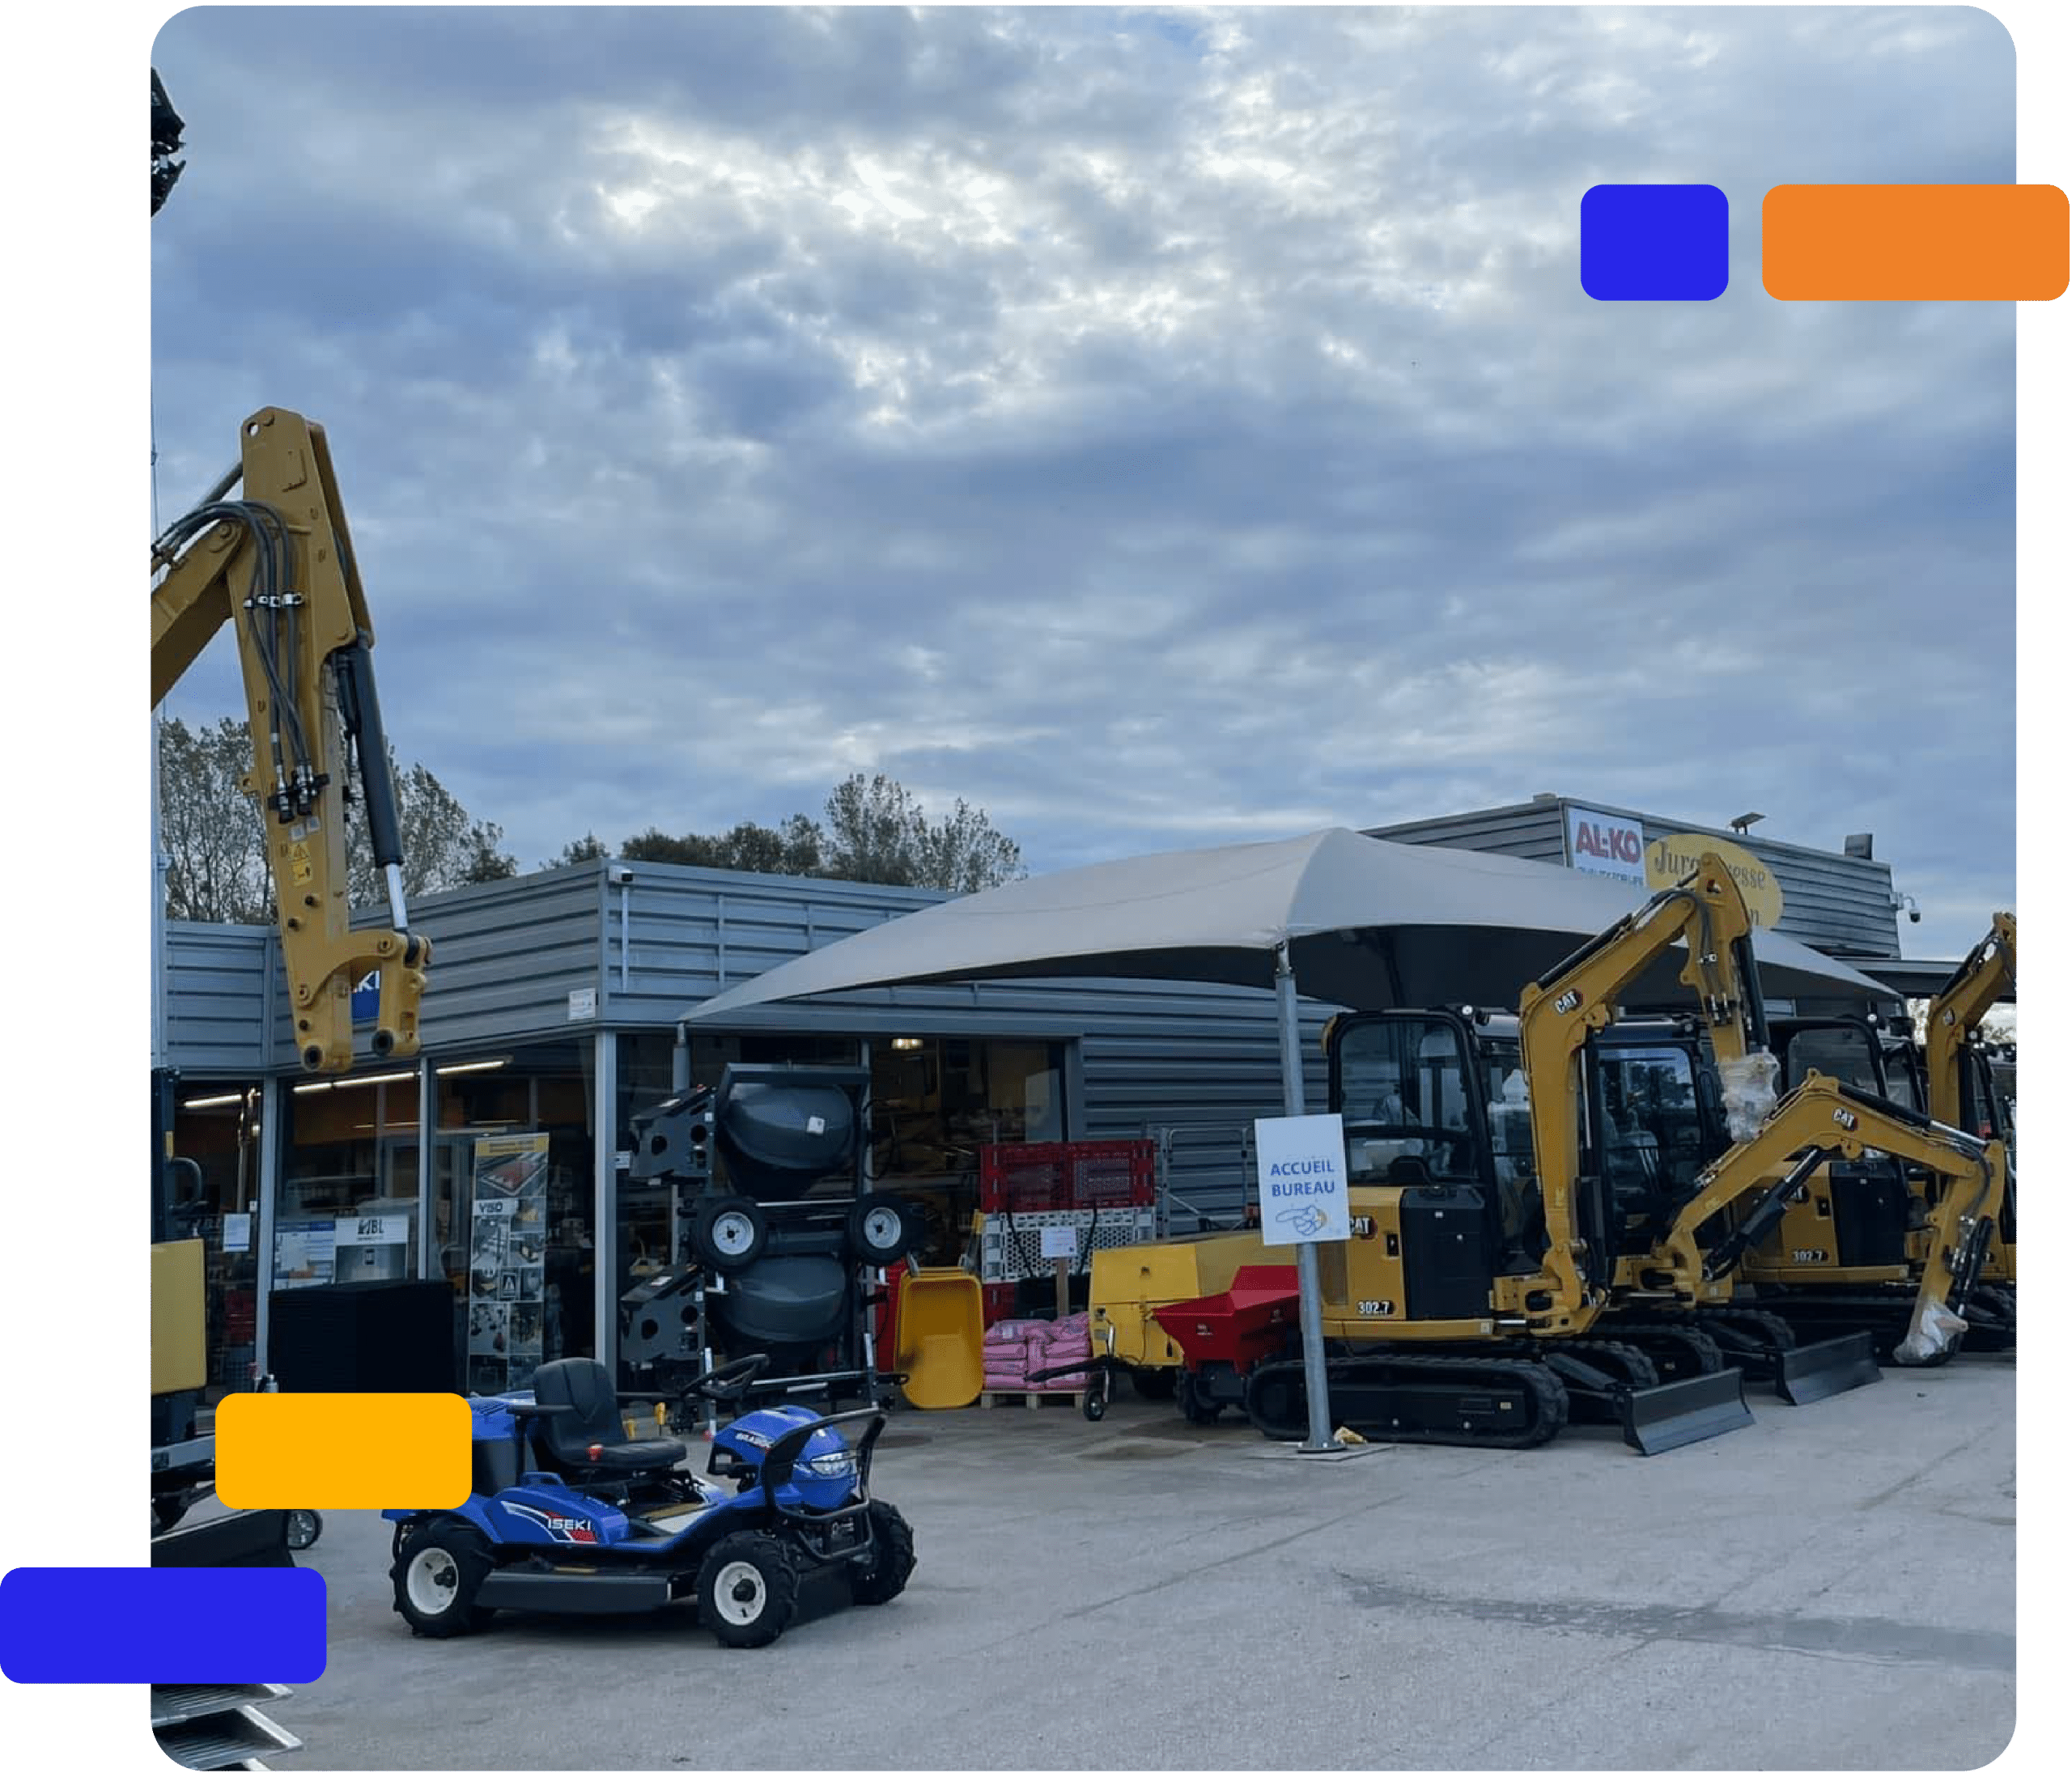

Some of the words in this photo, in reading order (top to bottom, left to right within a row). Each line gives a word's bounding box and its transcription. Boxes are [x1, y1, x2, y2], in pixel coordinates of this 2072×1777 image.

[1575, 821, 1642, 864] AL-KO
[1554, 990, 1577, 1014] CAT
[1832, 1107, 1855, 1127] CAT
[1270, 1160, 1335, 1176] ACCUEIL
[1272, 1180, 1335, 1197] BUREAU
[1357, 1300, 1391, 1315] 302.7
[547, 1518, 592, 1531] ISEKI
